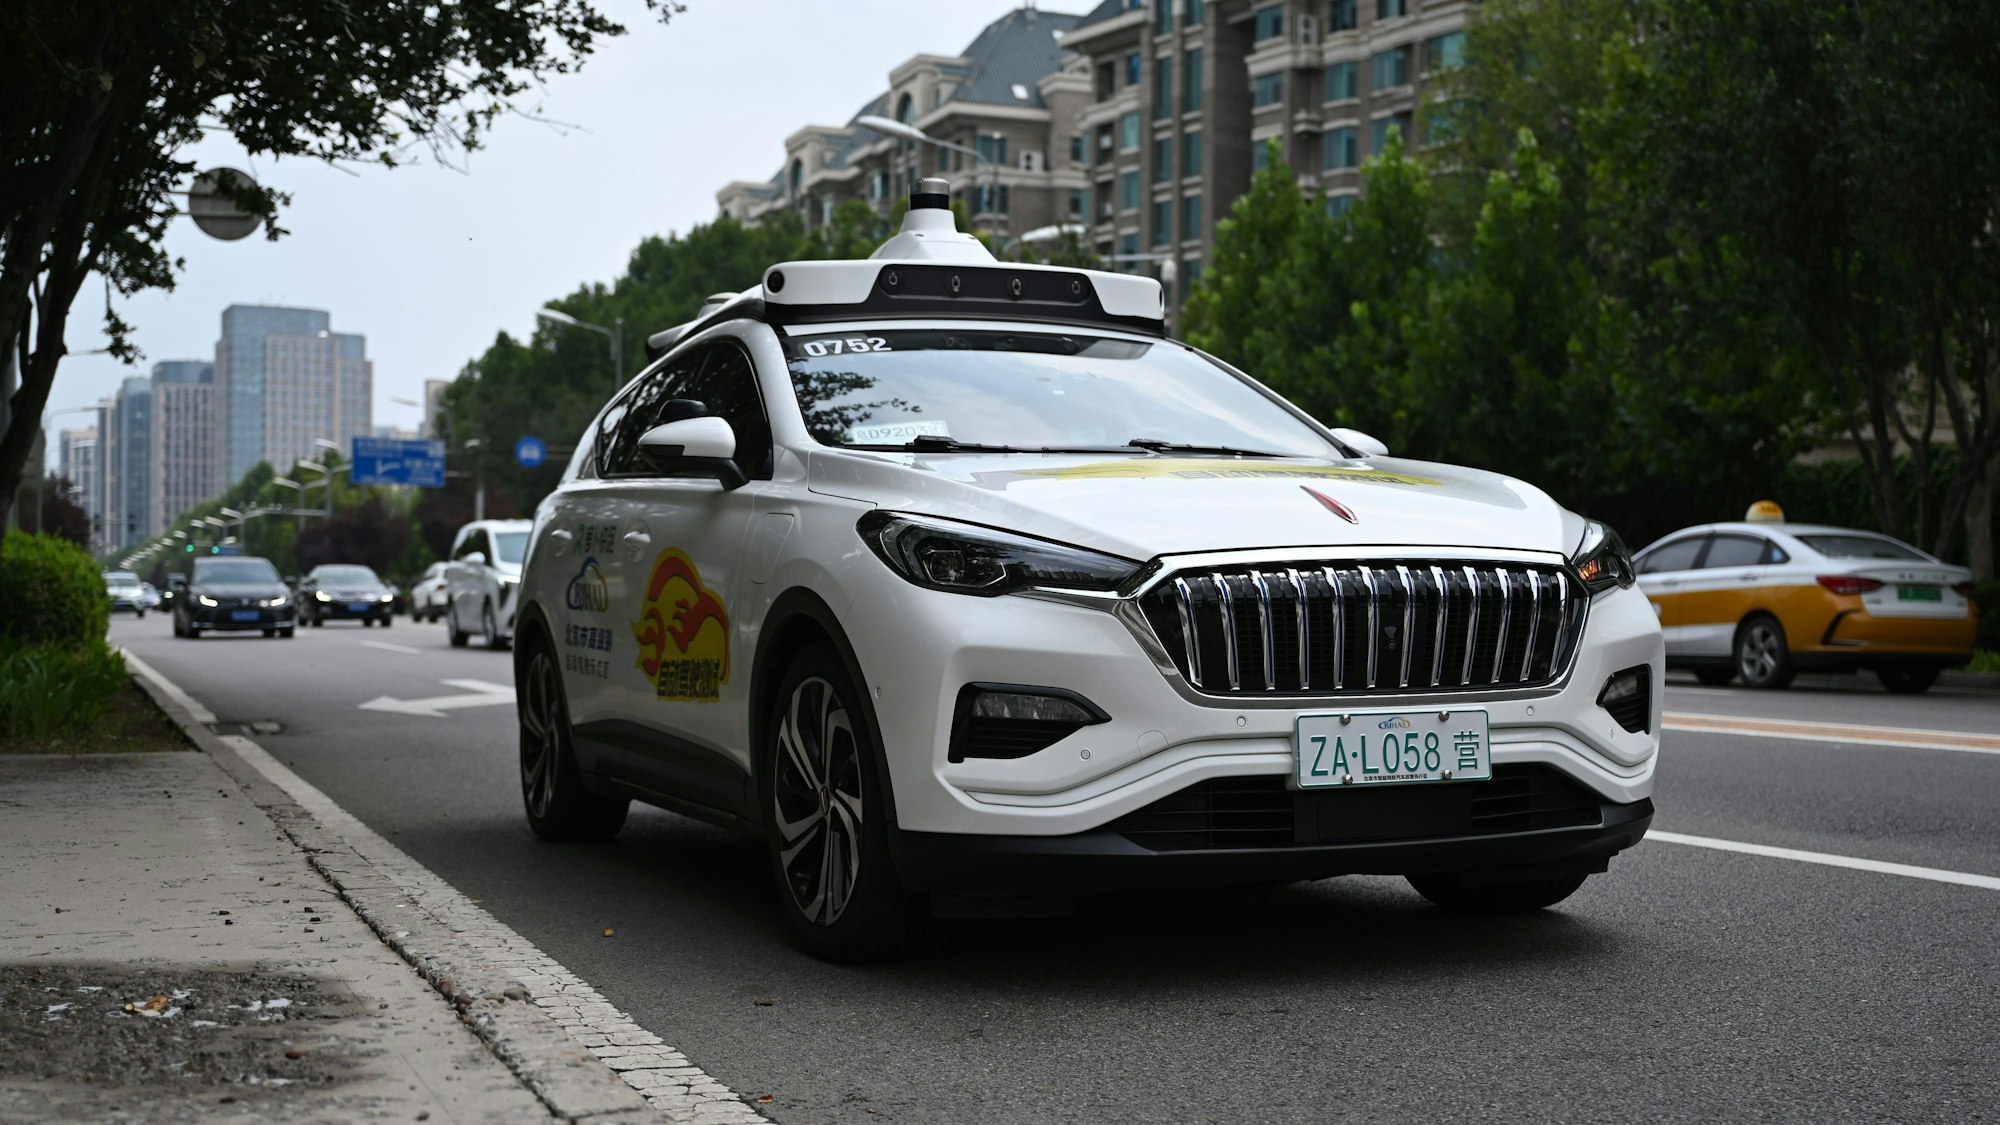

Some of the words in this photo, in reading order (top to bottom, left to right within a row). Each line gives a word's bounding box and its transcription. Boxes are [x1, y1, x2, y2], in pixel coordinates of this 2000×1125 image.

[803, 337, 892, 357] 0752
[566, 623, 613, 652] 北京市高级别
[657, 659, 720, 698] 自动驾驶测试
[1311, 732, 1441, 776] ZA·L058
[1453, 729, 1480, 770] 营
